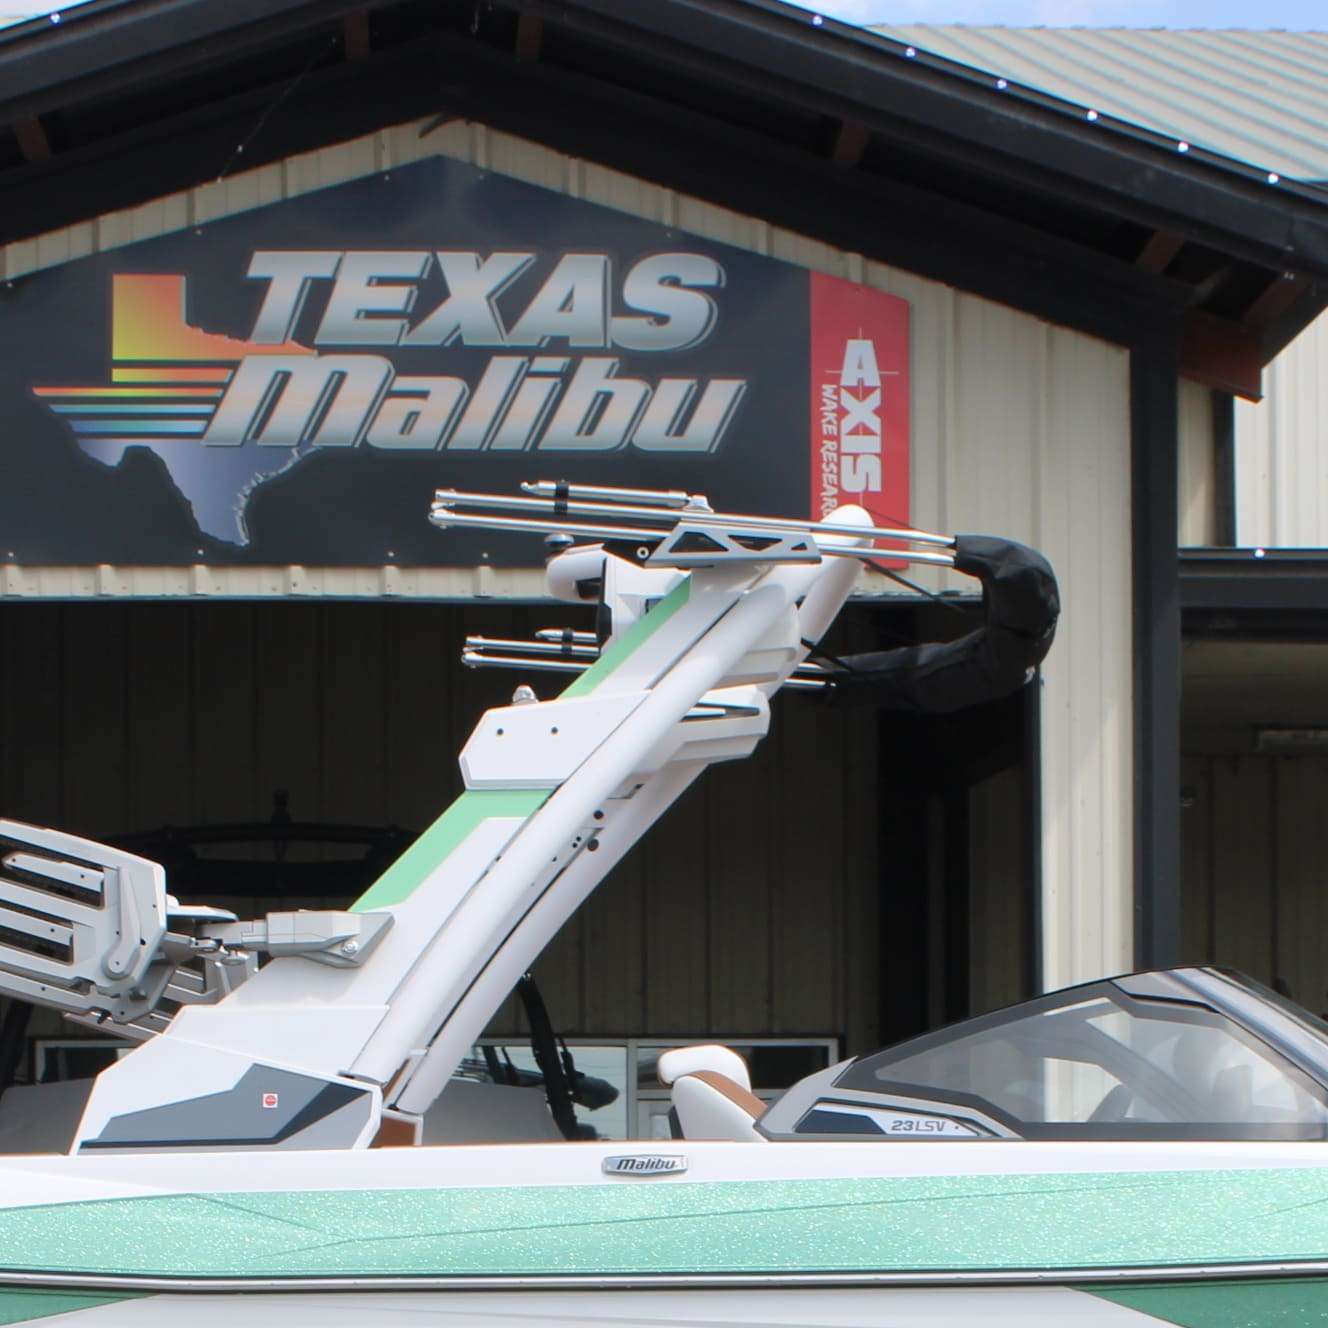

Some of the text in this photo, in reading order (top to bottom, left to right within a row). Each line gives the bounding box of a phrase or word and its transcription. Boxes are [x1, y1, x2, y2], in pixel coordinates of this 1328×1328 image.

[245, 248, 727, 352] TEXAS
[200, 352, 748, 453] Malibu
[820, 384, 838, 437] WAKE
[839, 339, 882, 493] AXIS
[615, 1157, 677, 1171] Malibu
